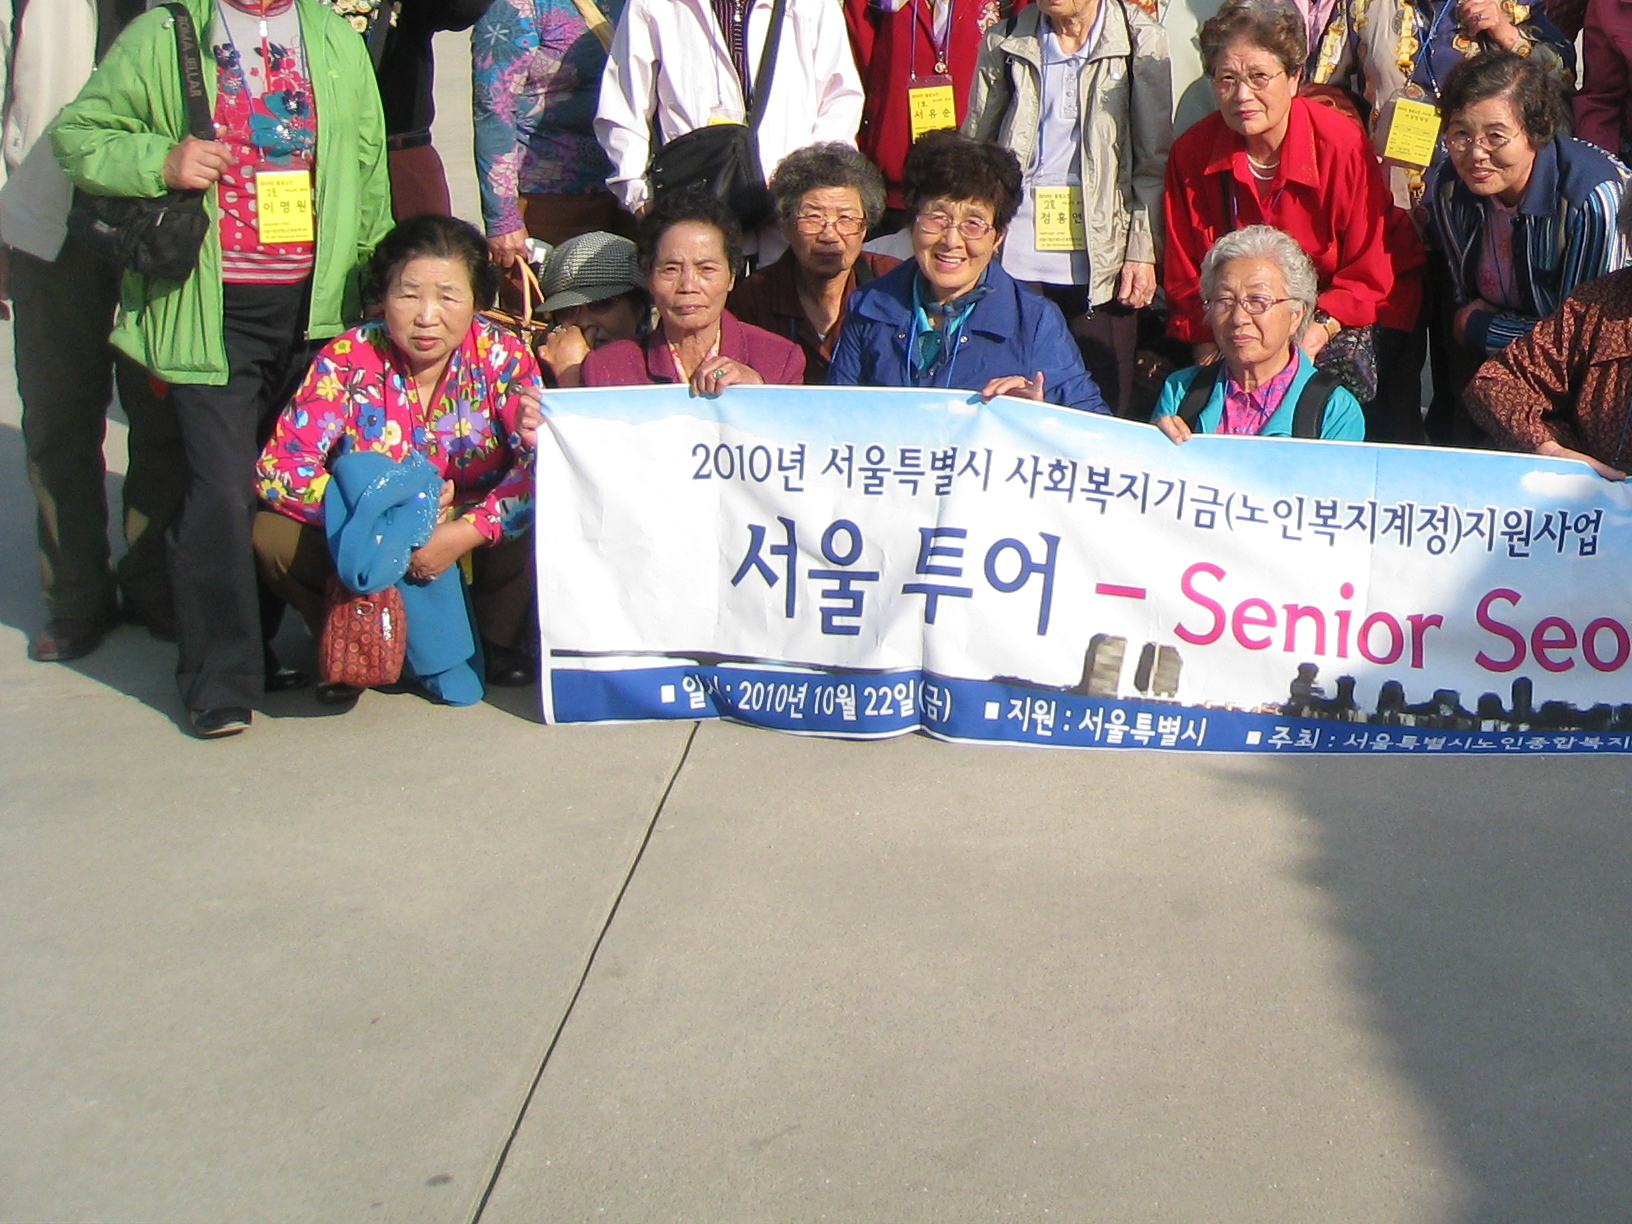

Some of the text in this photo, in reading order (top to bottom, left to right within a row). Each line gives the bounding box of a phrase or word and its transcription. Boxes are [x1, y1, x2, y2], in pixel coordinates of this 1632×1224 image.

[691, 442, 1605, 558] 2010년 서울특별시 사회복지기금(노인복지계정)지원사업
[731, 516, 880, 636] 서울
[901, 526, 1061, 636] 투어
[1174, 561, 1443, 670] Senior
[738, 680, 809, 720] 2010년
[813, 683, 857, 721] 10월
[864, 679, 952, 723] 22일(금)
[1007, 697, 1058, 736] 지원
[1078, 707, 1207, 747] 서울특별시
[1267, 725, 1321, 749] 주최
